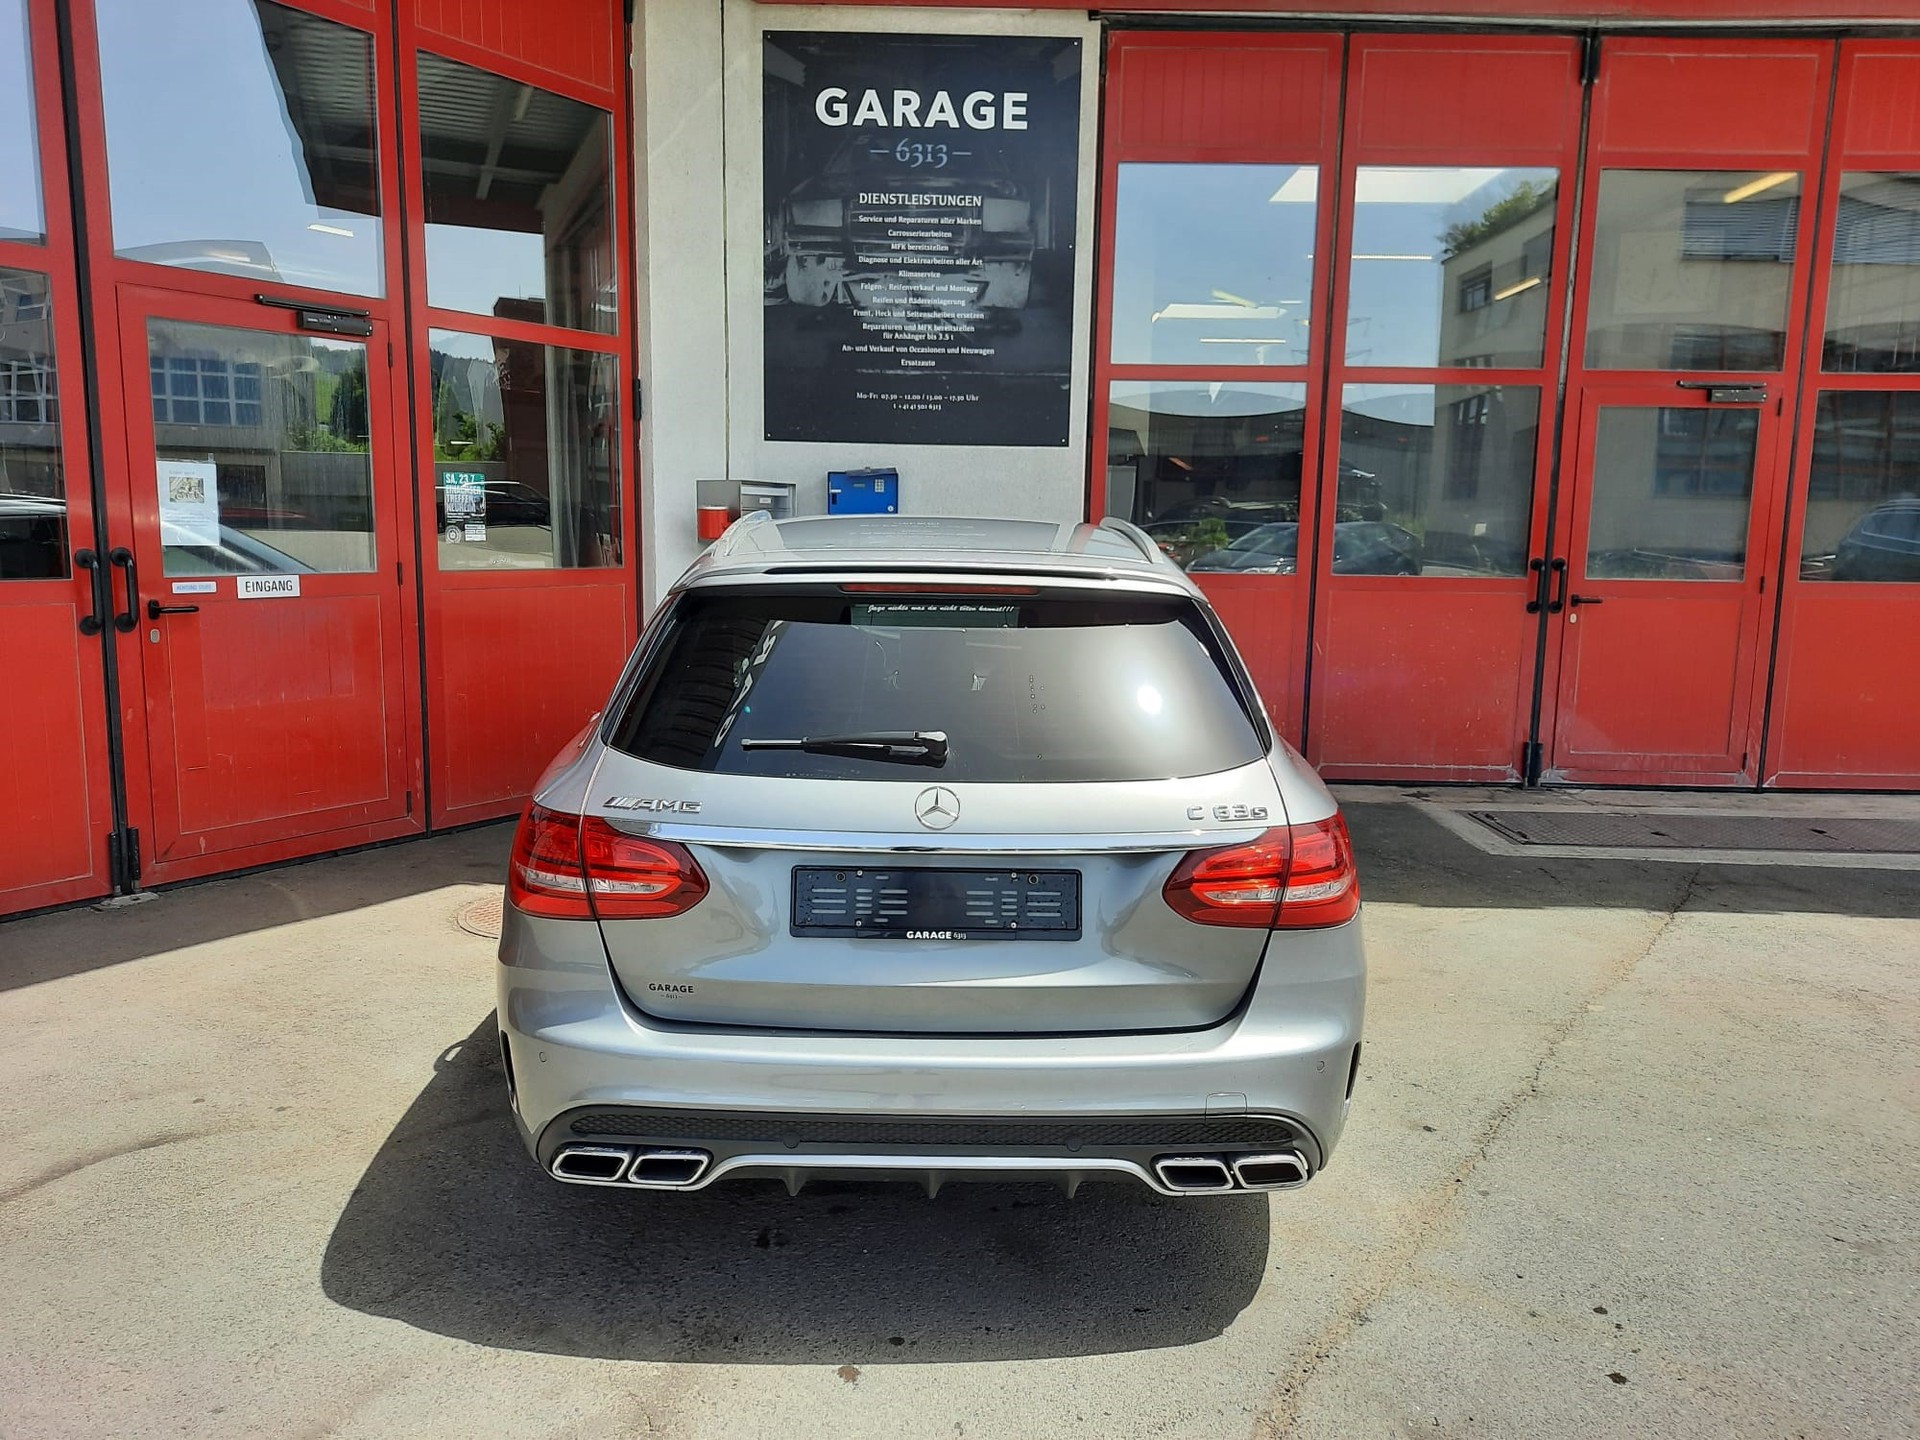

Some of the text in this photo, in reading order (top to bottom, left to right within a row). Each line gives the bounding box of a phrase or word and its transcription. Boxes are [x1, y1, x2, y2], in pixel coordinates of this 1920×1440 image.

[815, 87, 1028, 130] GARAGE
[895, 137, 948, 168] 6313
[859, 192, 982, 207] DIENSTLEISTUNGEN
[858, 214, 982, 226] Service und Reparaturen aller Marken
[888, 229, 952, 238] Carrosseriearbeiten
[907, 243, 949, 252] bereitstellen
[858, 255, 983, 266] Diagnose und Elektroarbeiten aller Art
[898, 270, 941, 279] Klimaservice
[888, 283, 934, 292] Reifenverkauf
[935, 284, 949, 292] und
[949, 284, 978, 294] Montage
[872, 296, 894, 304] Reifen
[892, 310, 905, 318] und
[906, 310, 955, 319] Seitenscheiben
[956, 312, 985, 320] ersetzen
[862, 322, 903, 331] Reparaturen
[903, 323, 917, 331] und
[917, 324, 933, 332] MFK
[882, 332, 893, 340] für
[894, 332, 926, 341] Anhänger
[926, 333, 937, 341] bis
[841, 344, 854, 352] An-
[854, 344, 868, 352] und
[868, 345, 895, 353] Verkauf
[908, 346, 946, 354] Occasionen
[946, 346, 960, 354] und
[960, 347, 995, 356] Neuwagen
[900, 358, 936, 367] Ersatzauto
[965, 394, 980, 402] Uhr
[245, 580, 294, 593] EINGANG
[1187, 806, 1204, 821] C
[906, 931, 952, 940] GARAGE
[648, 983, 694, 994] GARAGE
